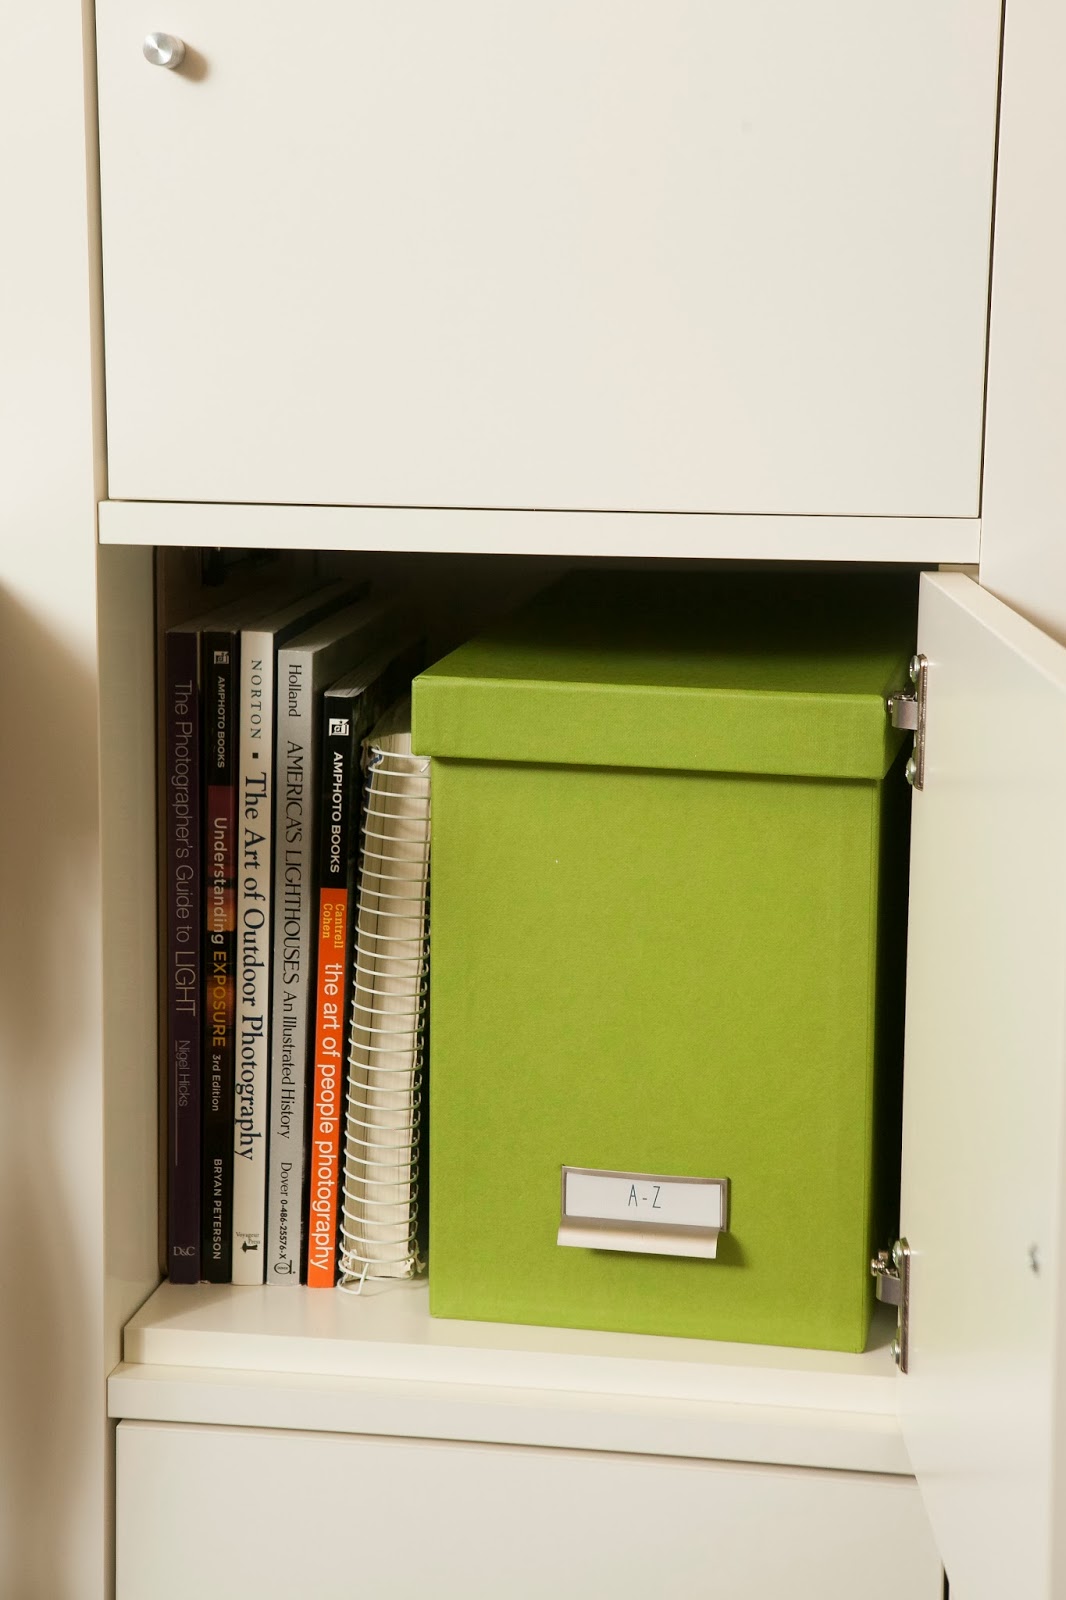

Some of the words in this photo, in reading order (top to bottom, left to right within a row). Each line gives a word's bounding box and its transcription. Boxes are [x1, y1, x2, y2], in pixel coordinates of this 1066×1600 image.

[174, 680, 192, 715] The
[217, 676, 226, 729] AMPHOTO
[251, 660, 262, 739] NORTON
[288, 664, 302, 717] Holland
[217, 732, 225, 768] BOOKS
[172, 721, 193, 858] Photographer's
[244, 771, 267, 820] The
[285, 741, 304, 844] AMERICA'S
[331, 752, 344, 822] AMPHOTO
[244, 828, 266, 869] Art
[330, 825, 341, 873] BOOKS
[175, 865, 194, 919] Guide
[211, 817, 228, 944] Understanding
[244, 878, 265, 901] of
[176, 926, 192, 943] to
[283, 850, 302, 985] LIGHTHOUSES
[323, 903, 333, 939] Cohen
[334, 904, 345, 948] Cantrell
[242, 908, 265, 1007] Outdoor
[323, 963, 343, 996] the
[175, 951, 196, 1016] LIGHT
[212, 951, 226, 1047] EXPOSURE
[284, 990, 297, 1012] An
[323, 1002, 340, 1030] art
[176, 1040, 191, 1071] Nigel
[212, 1054, 221, 1072] 3rd
[281, 1016, 297, 1085] Illustrated
[322, 1037, 341, 1058] of
[178, 1073, 191, 1107] Hicks
[211, 1075, 221, 1111] Edition
[235, 1015, 263, 1161] Photography
[315, 1064, 338, 1134] people
[277, 1089, 296, 1139] History
[213, 1158, 222, 1196] BRYAN
[280, 1162, 293, 1196] Dover
[212, 1201, 222, 1259] PETERSON
[279, 1199, 288, 1259] 0-486-25576-X
[310, 1141, 338, 1270] photography
[173, 1246, 195, 1256] D&C
